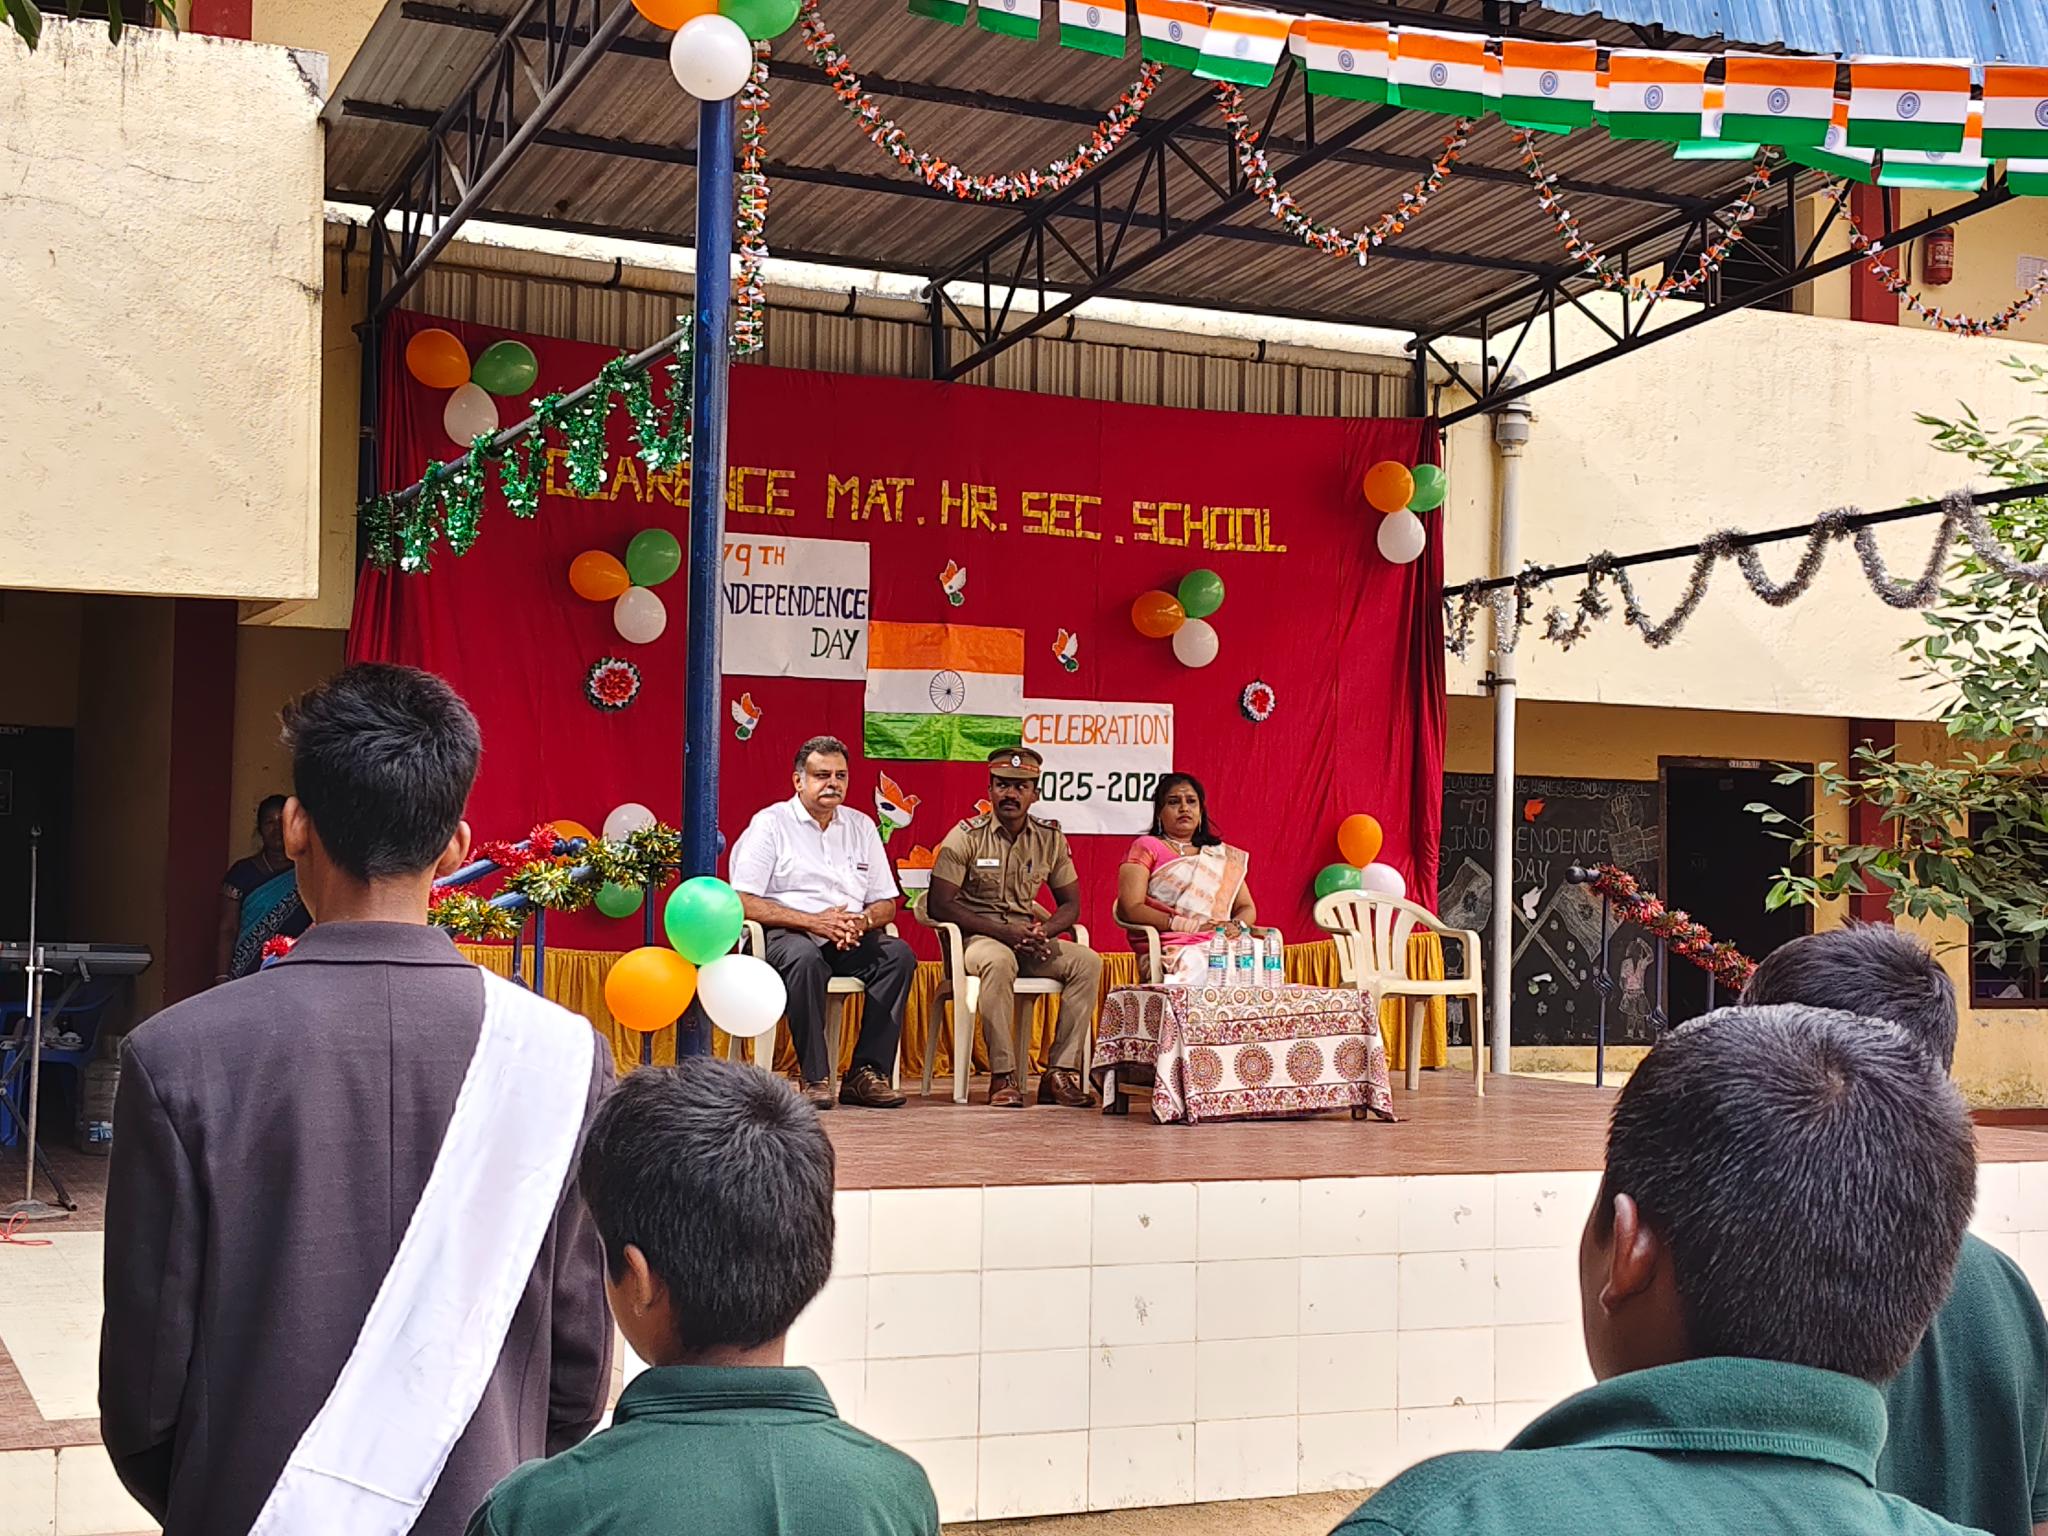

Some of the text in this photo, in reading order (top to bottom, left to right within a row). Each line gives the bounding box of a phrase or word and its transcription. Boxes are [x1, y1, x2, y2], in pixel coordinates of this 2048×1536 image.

[1132, 500, 1287, 552] SCHOOL
[810, 627, 860, 660] DAY
[1022, 713, 1169, 745] CELEBRATION
[1038, 771, 1173, 802] 025-202
[1460, 799, 1487, 825] 79
